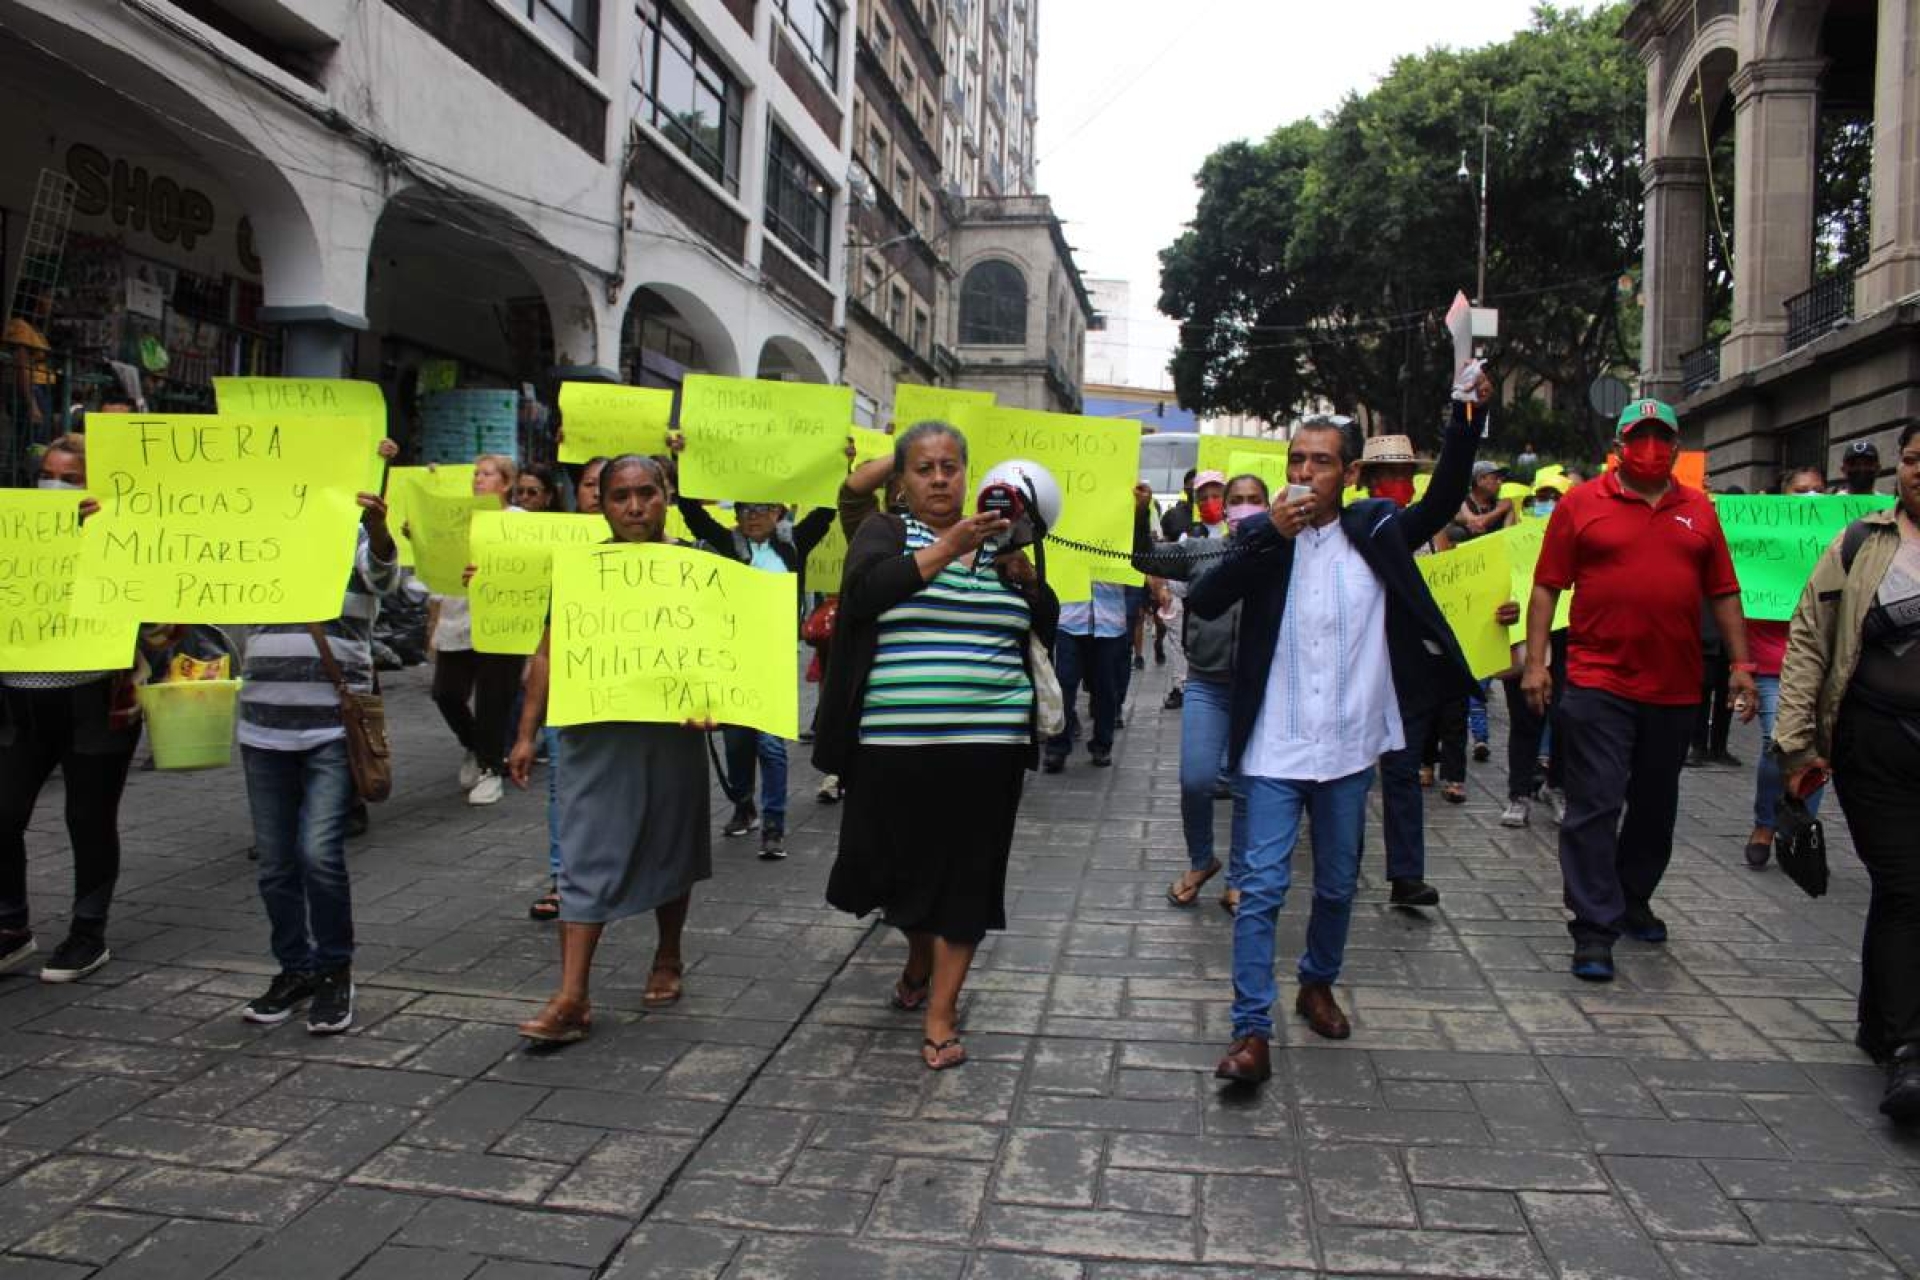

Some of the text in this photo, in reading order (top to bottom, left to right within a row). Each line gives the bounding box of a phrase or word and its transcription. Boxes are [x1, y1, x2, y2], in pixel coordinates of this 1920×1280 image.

[65, 143, 215, 252] SHOP
[245, 382, 339, 411] FUERA
[128, 421, 283, 467] FUERA
[985, 415, 1118, 457] EXIGIMOS
[96, 572, 285, 609] DE PATIOS
[592, 550, 727, 598] FUERA
[7, 616, 26, 645] A
[589, 676, 763, 717] DE PATIOS
